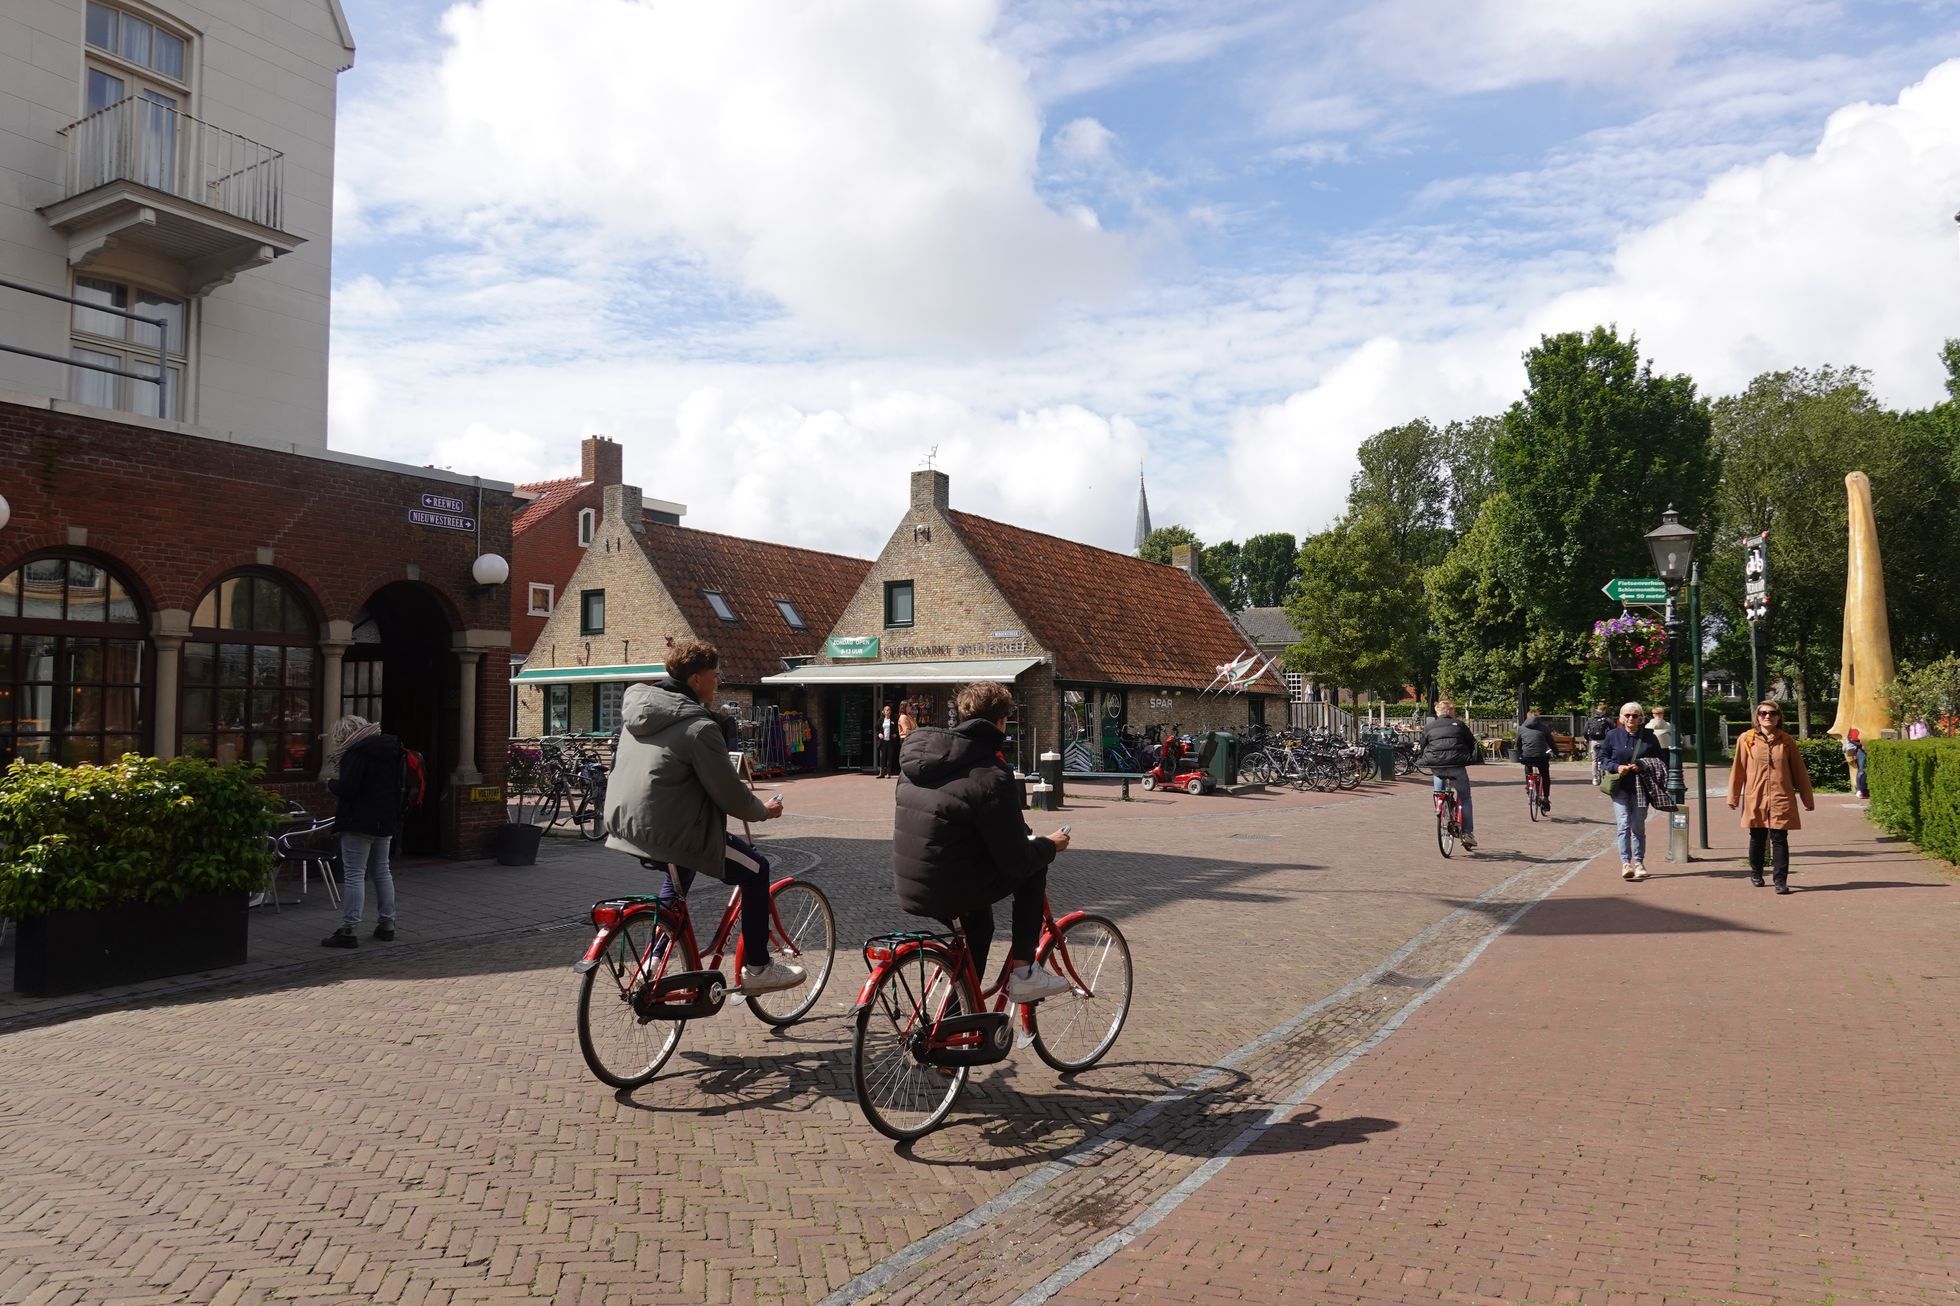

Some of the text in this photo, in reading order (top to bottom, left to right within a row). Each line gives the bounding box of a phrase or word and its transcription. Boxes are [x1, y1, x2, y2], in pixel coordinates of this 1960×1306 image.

[433, 497, 461, 511] REEWEG
[412, 512, 464, 528] NIEUWESTREEK
[883, 645, 952, 658] SUPERMARKT
[1150, 698, 1173, 709] SPAR
